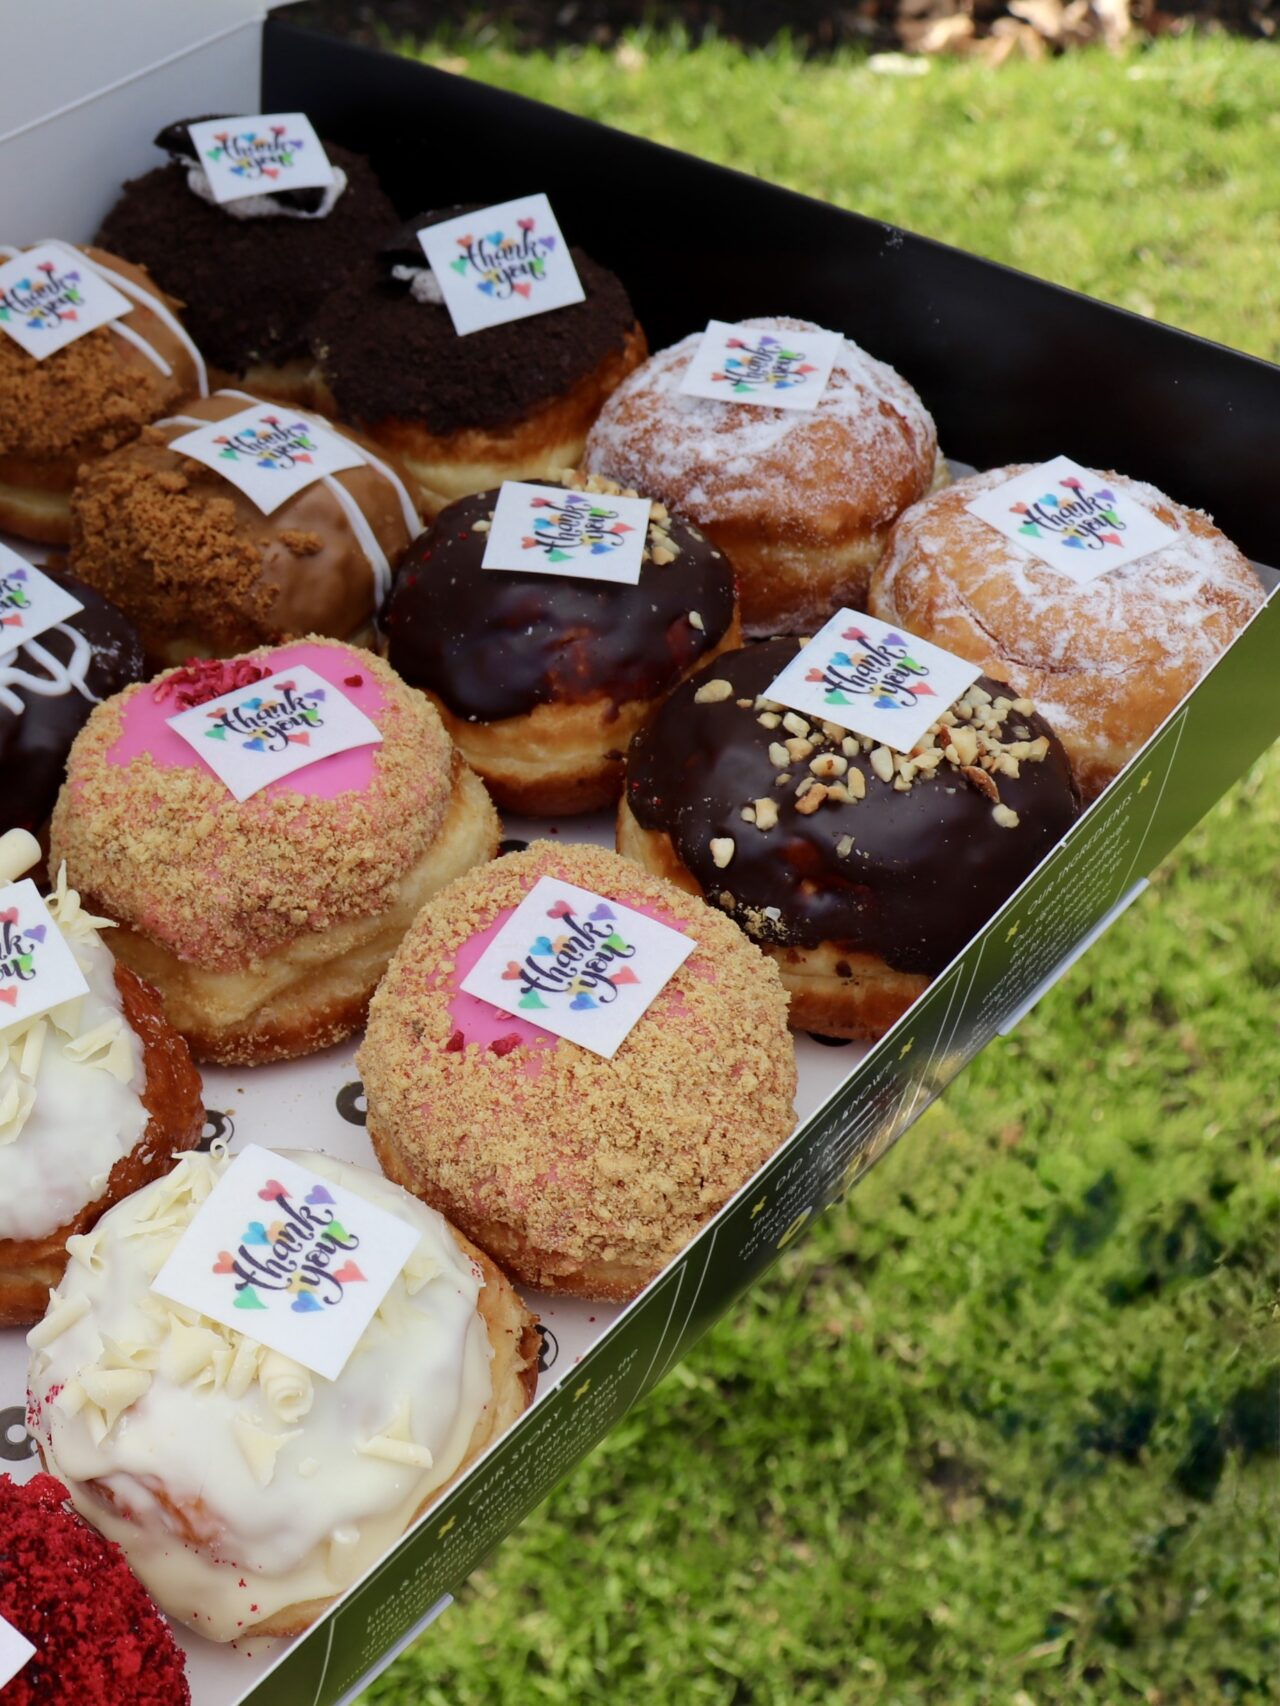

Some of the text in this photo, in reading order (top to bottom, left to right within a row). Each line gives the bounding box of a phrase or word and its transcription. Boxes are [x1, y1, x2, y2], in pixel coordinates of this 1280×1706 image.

[215, 133, 295, 160] thank
[247, 153, 294, 178] you
[459, 227, 547, 273] thank
[0, 270, 76, 314] thank
[495, 258, 547, 299] you
[42, 294, 84, 328] you
[724, 343, 783, 386] thank
[772, 353, 807, 384] you
[223, 423, 305, 456] thank
[269, 440, 317, 469] you
[534, 502, 592, 554] thank
[584, 511, 625, 546] you
[1023, 486, 1112, 532] thank
[1077, 513, 1126, 550] you
[823, 636, 907, 694] thank
[880, 660, 929, 707] you
[214, 690, 318, 734] thank
[265, 713, 324, 752] you
[1027, 881, 1055, 915] OUR
[1057, 792, 1131, 882] INGREDIENTS
[519, 912, 614, 994] thank
[577, 944, 636, 1004] you
[776, 1157, 802, 1190] DID
[808, 1119, 837, 1155] YOU
[233, 1193, 334, 1292] thank
[299, 1231, 360, 1306] you
[468, 1408, 560, 1507] OUR STORY
